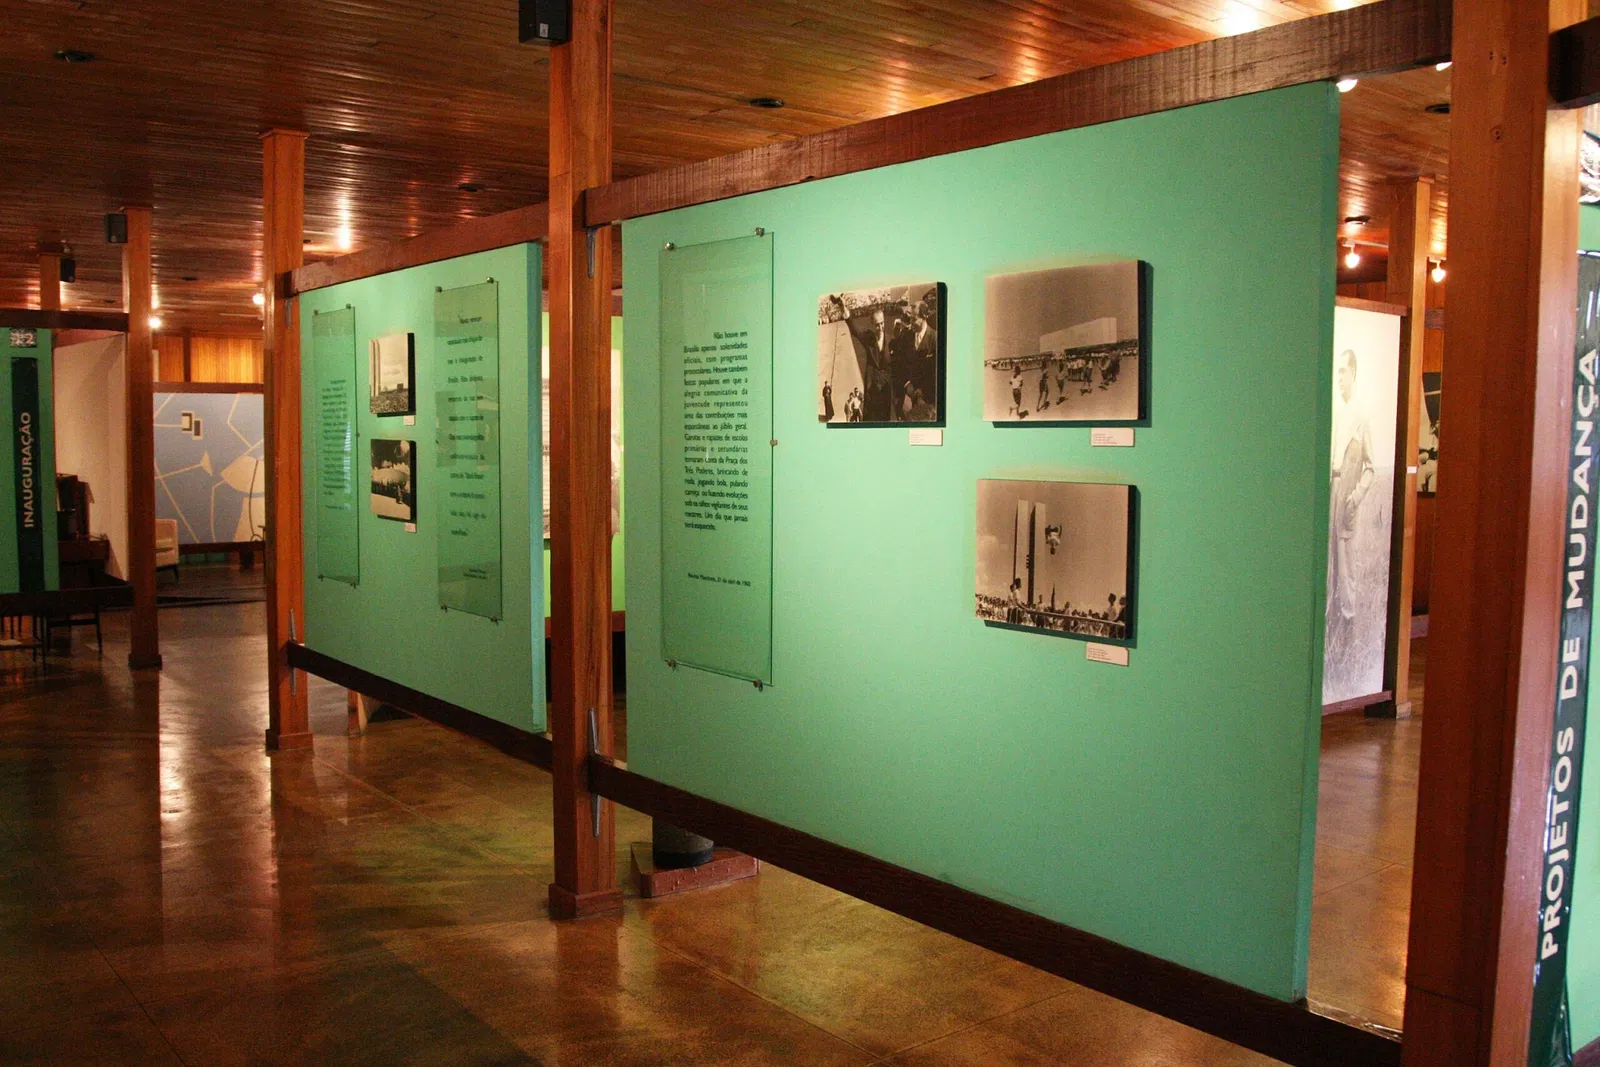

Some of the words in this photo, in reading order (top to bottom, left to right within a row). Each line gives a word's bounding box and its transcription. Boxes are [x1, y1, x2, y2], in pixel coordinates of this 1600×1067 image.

[720, 354, 748, 363] programas
[704, 389, 738, 397] comunicativa
[741, 387, 748, 395] da
[724, 433, 730, 441] de
[739, 456, 748, 464] dos
[19, 411, 35, 528] INAUGURAÇÃO
[741, 468, 748, 476] de
[1566, 349, 1598, 609] MUDANÇA
[723, 514, 733, 523] que
[1560, 636, 1581, 701] DE
[1541, 726, 1574, 961] PROJETOS
